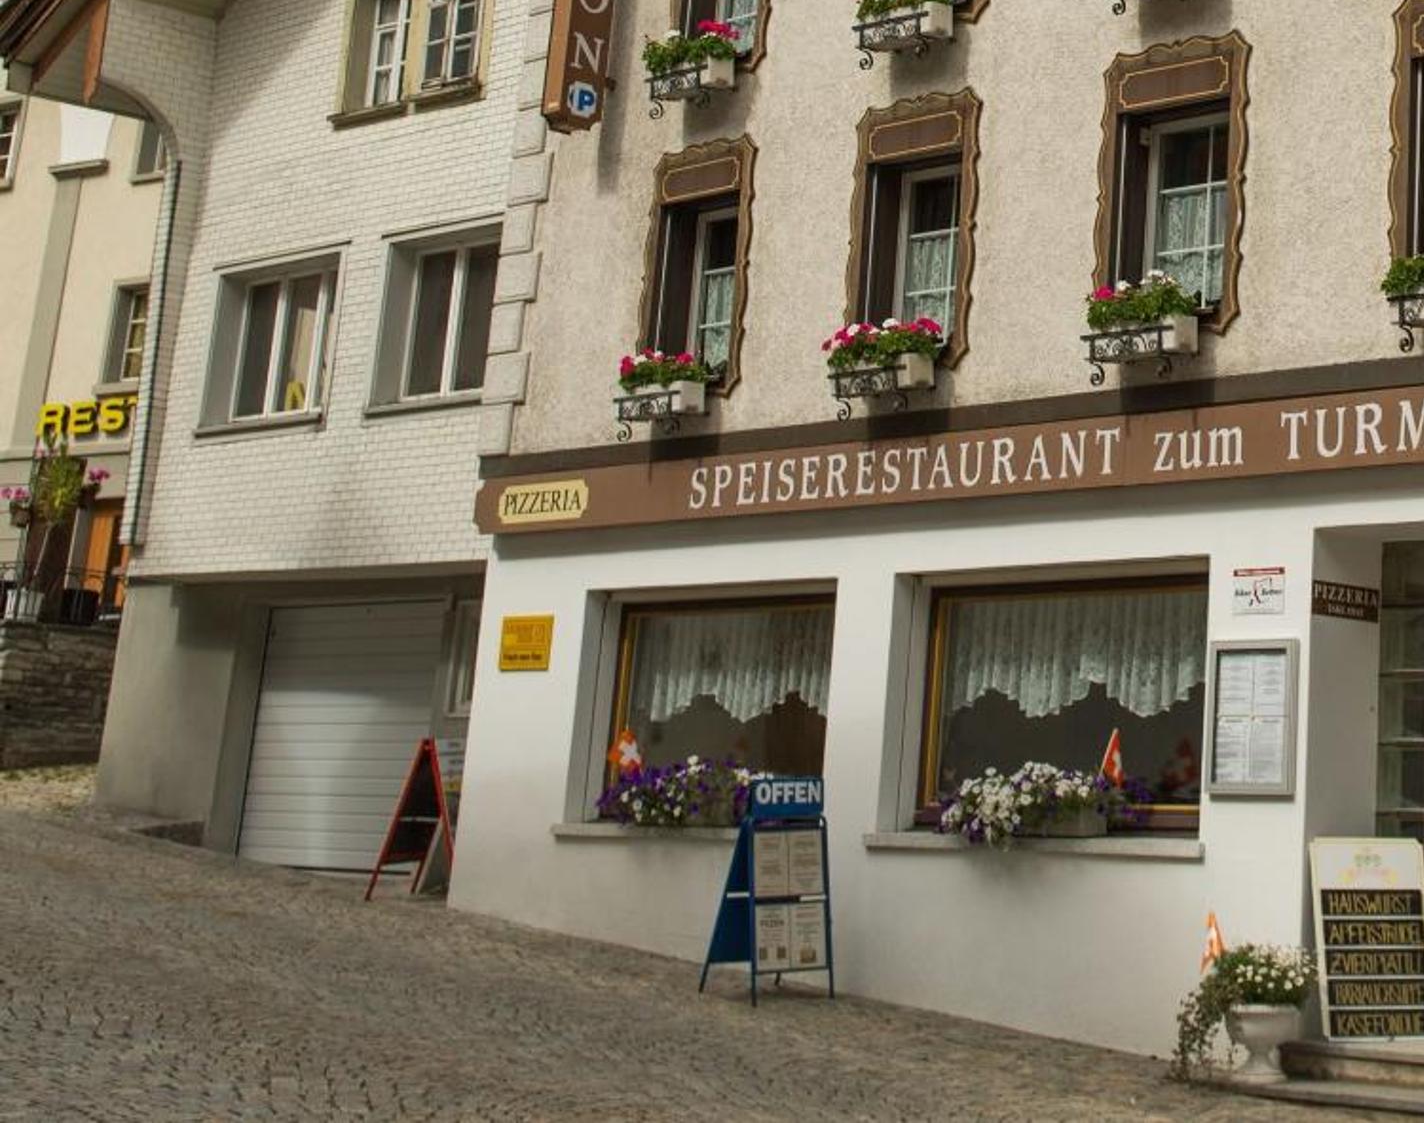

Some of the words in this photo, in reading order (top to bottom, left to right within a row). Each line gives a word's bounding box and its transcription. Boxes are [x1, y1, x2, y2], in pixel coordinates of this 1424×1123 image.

[689, 426, 1121, 510] SPEISERESTAURANT
[1153, 425, 1244, 472] zum
[503, 489, 582, 517] PIZZERIA
[1314, 582, 1379, 607] PIZZERIA
[756, 782, 821, 805] OFFEN
